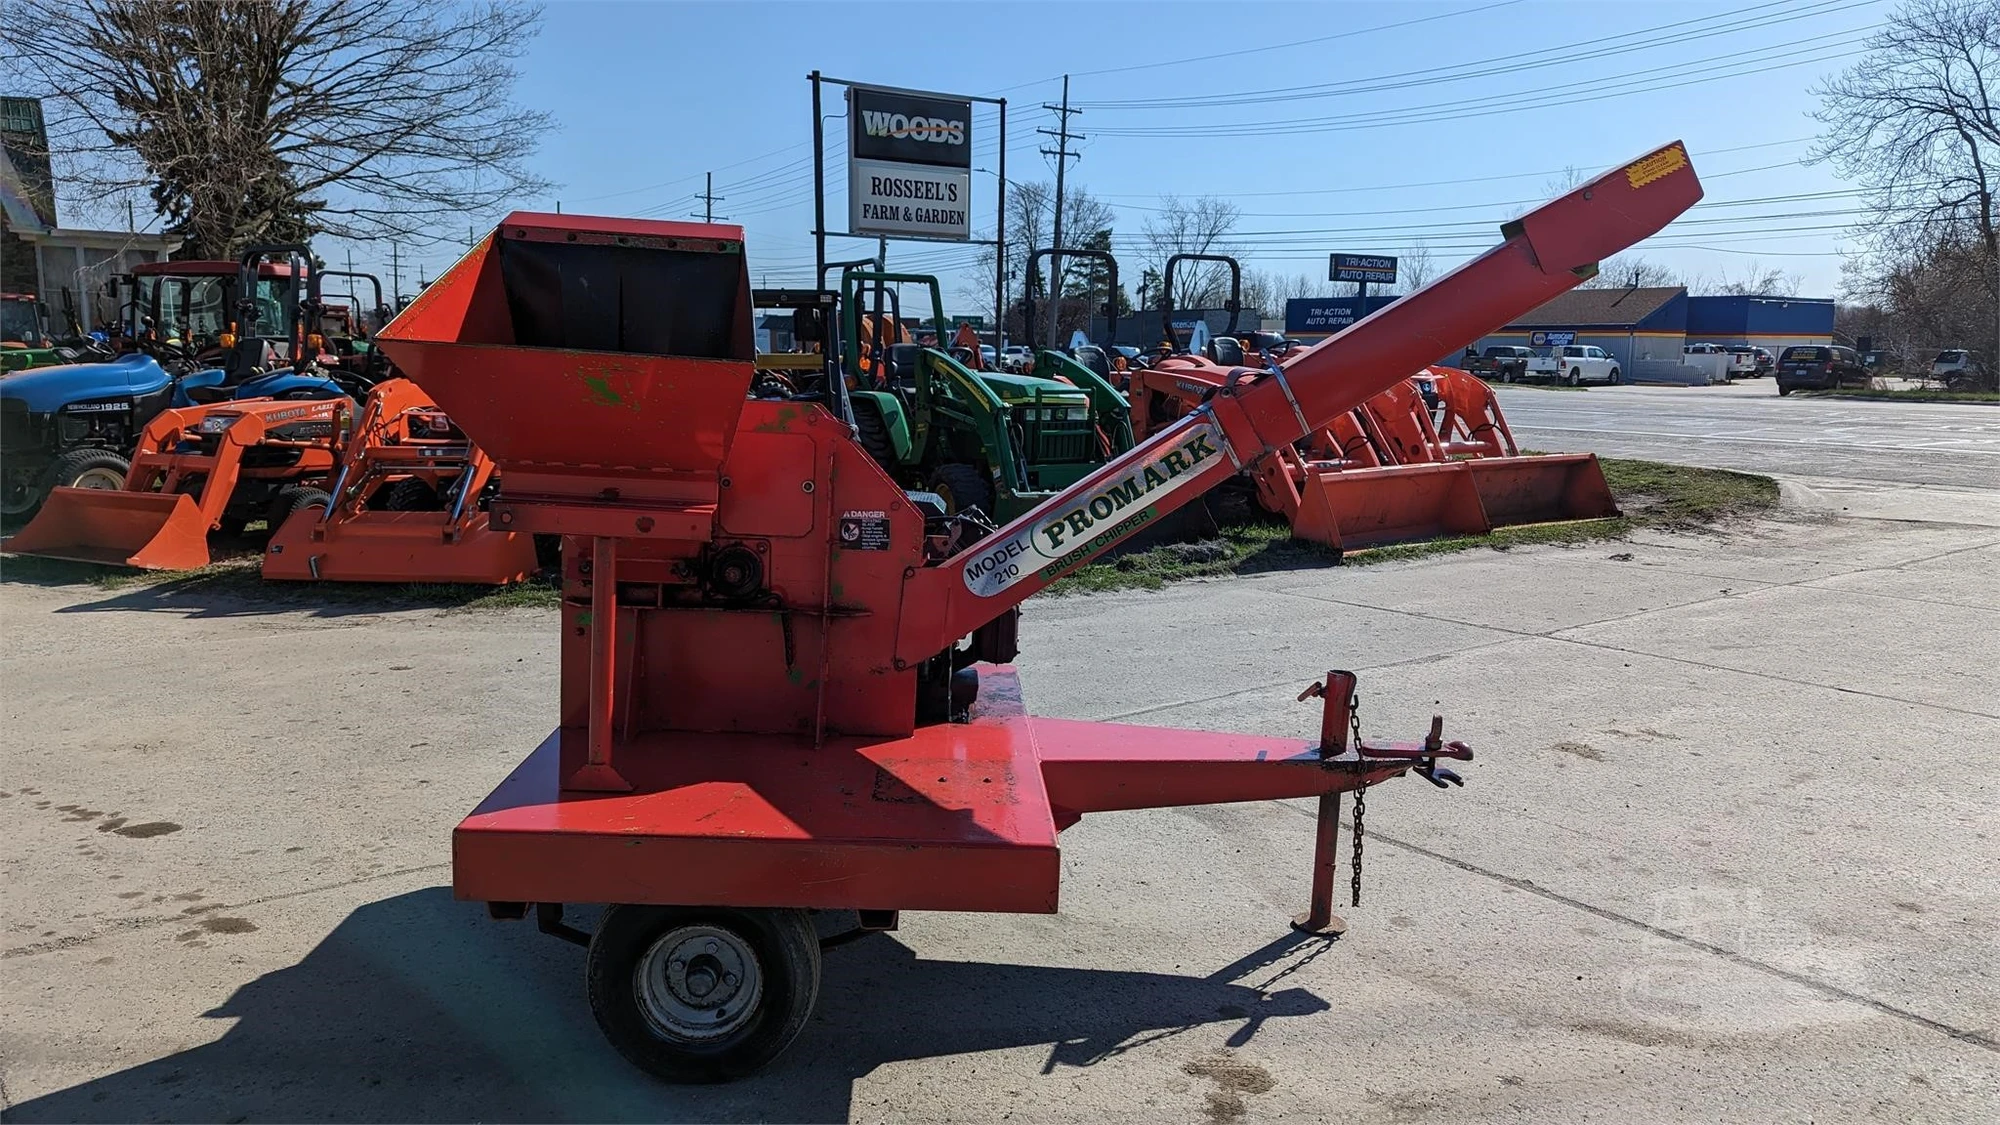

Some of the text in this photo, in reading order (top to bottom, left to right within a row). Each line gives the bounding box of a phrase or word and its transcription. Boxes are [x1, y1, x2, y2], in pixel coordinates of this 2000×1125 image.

[862, 110, 964, 145] WOODS
[1641, 155, 1667, 170] CAUTION
[871, 176, 958, 203] ROSSEEL'S
[862, 203, 965, 226] FARM & GARDEN
[1340, 270, 1395, 281] AUTO REPAIR
[1305, 317, 1354, 325] AUTO REPAIR
[101, 402, 129, 411] 1925
[265, 408, 307, 422] KUBOTA
[1041, 432, 1218, 550] PROMARK
[850, 510, 885, 518] DANGER
[1046, 509, 1150, 577] BRUSH CHIPPER
[965, 537, 1031, 583] MODEL
[994, 563, 1020, 586] 210
